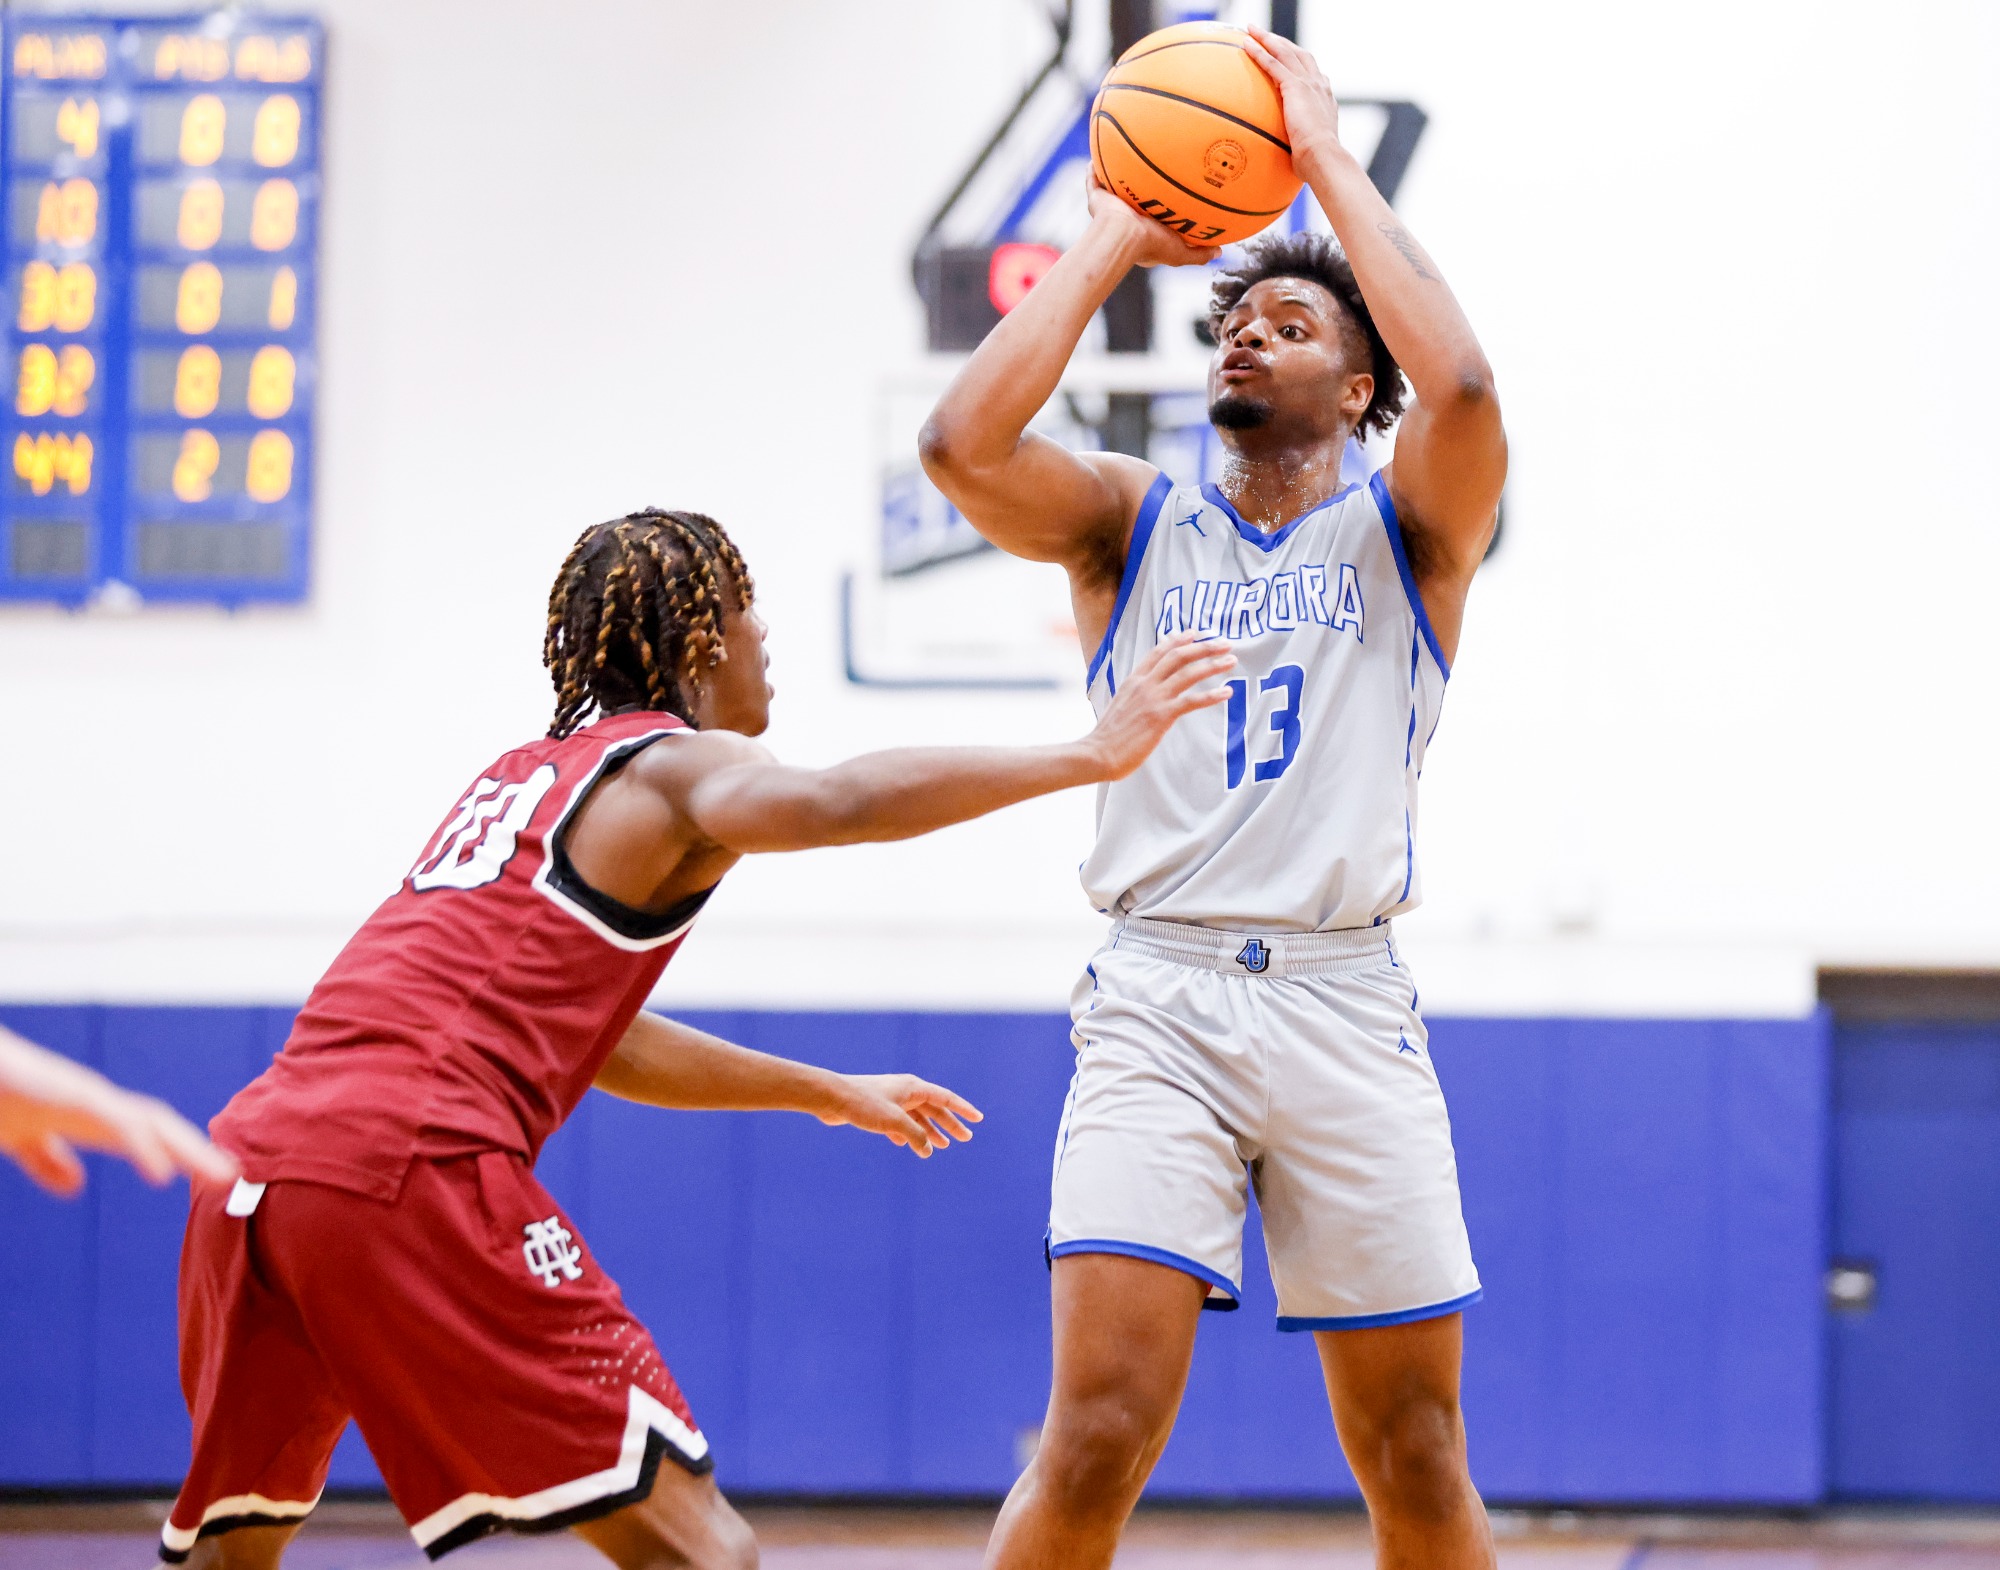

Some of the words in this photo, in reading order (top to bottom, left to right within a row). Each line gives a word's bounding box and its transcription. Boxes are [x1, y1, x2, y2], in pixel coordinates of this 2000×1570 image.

[56, 98, 100, 158] 4
[1137, 199, 1226, 241] EVO
[268, 265, 297, 331] 1
[13, 431, 94, 496] 44
[1155, 563, 1364, 645] AURORA
[1222, 661, 1306, 792] 13
